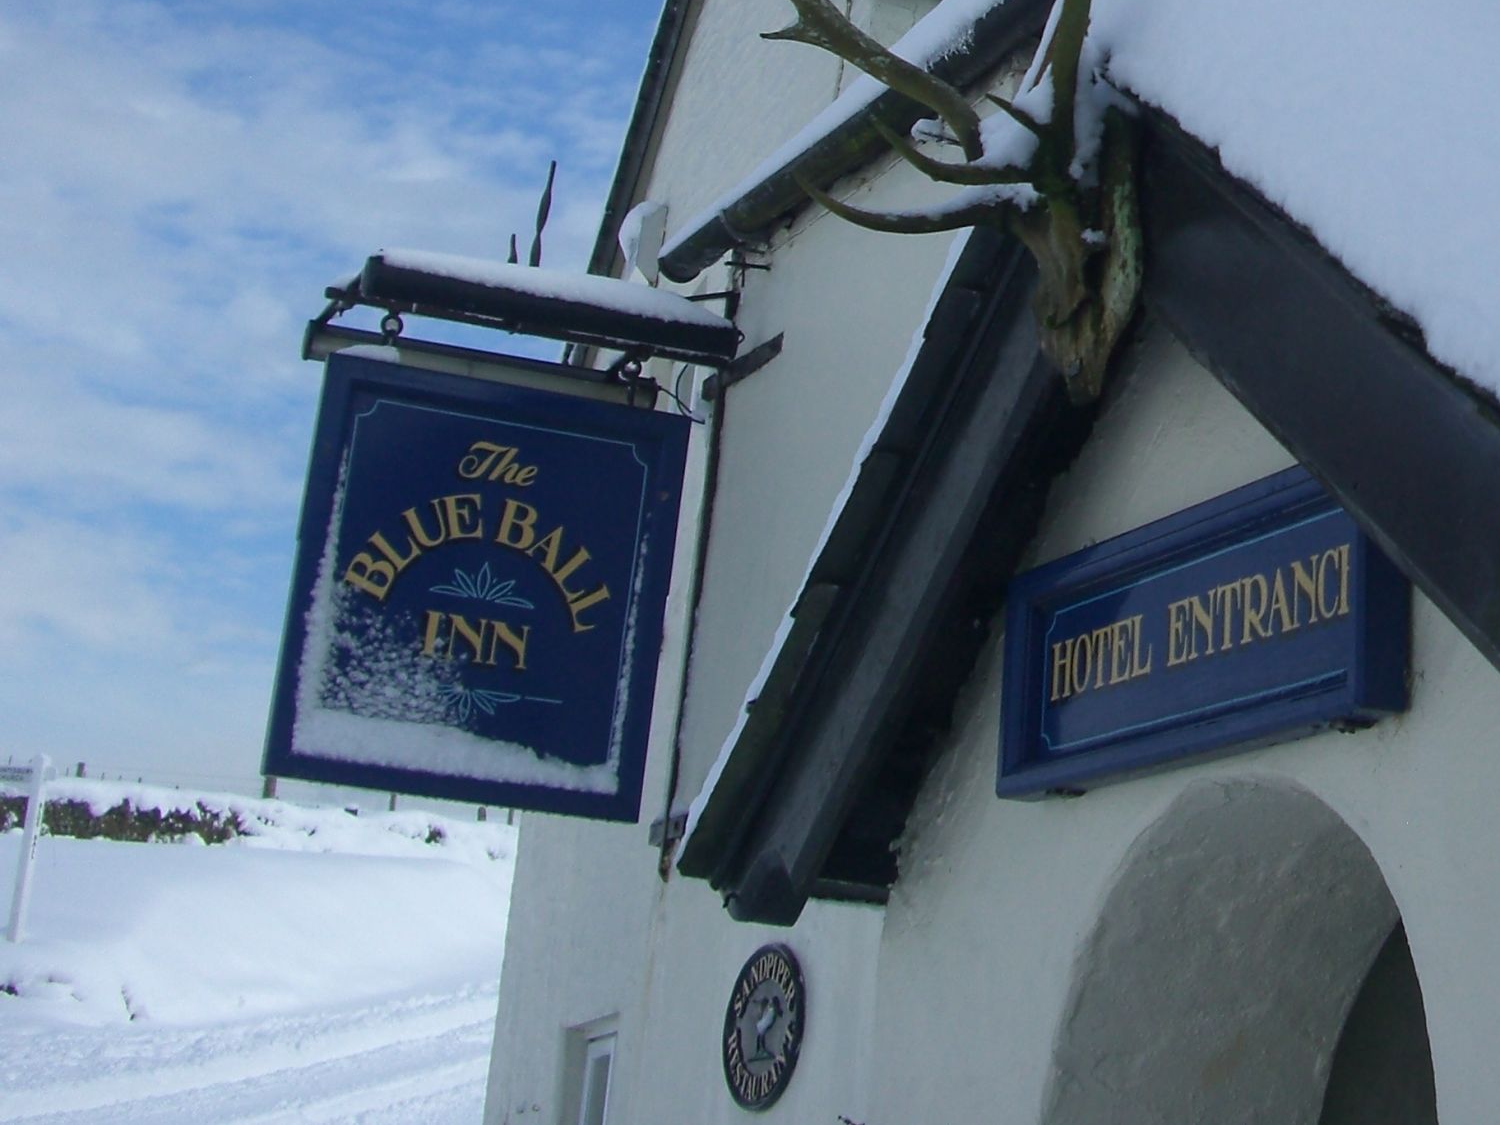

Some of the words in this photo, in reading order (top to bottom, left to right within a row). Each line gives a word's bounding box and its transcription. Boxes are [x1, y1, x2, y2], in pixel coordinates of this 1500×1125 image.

[458, 440, 540, 487] The
[342, 492, 484, 602] BLUE
[494, 497, 611, 633] BALL
[421, 609, 530, 670] INN
[1050, 614, 1152, 702] HOTEL
[734, 953, 796, 1017] SANDPIPER
